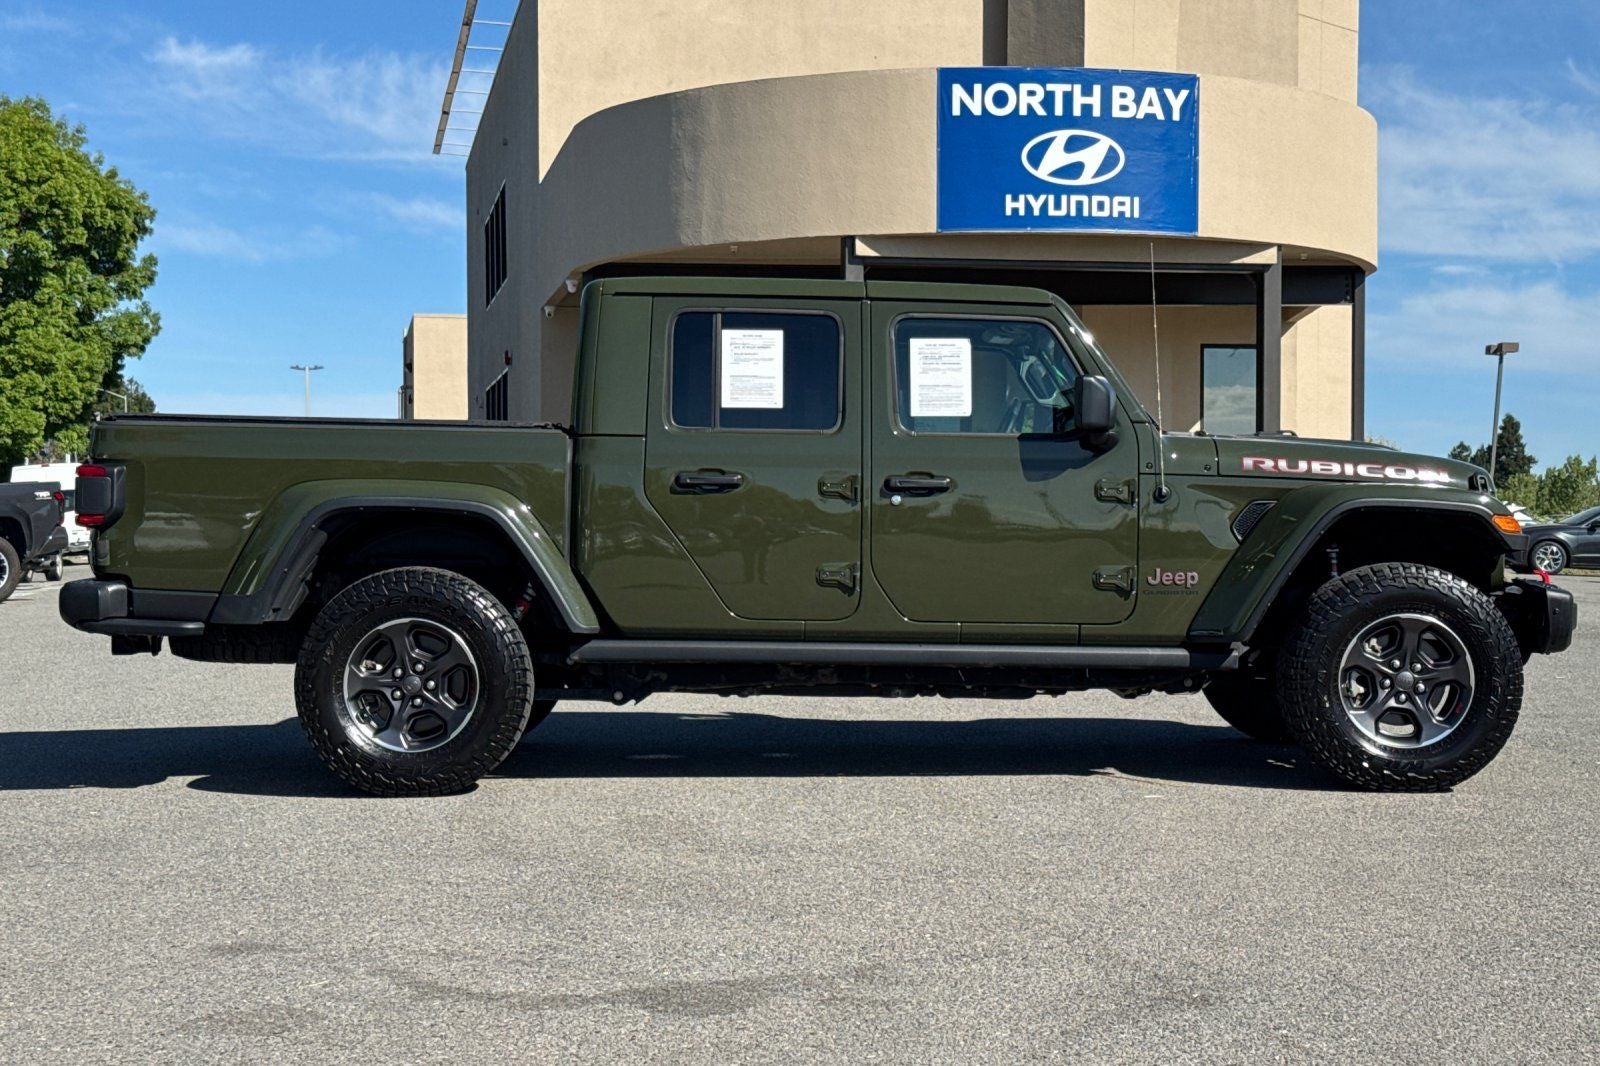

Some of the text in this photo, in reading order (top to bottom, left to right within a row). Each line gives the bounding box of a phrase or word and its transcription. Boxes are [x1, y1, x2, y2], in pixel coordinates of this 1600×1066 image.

[951, 82, 1190, 121] NORTH BAY
[1004, 193, 1140, 219] HYUNDAI
[1241, 456, 1453, 484] RUBICON
[1147, 567, 1199, 589] Jeep
